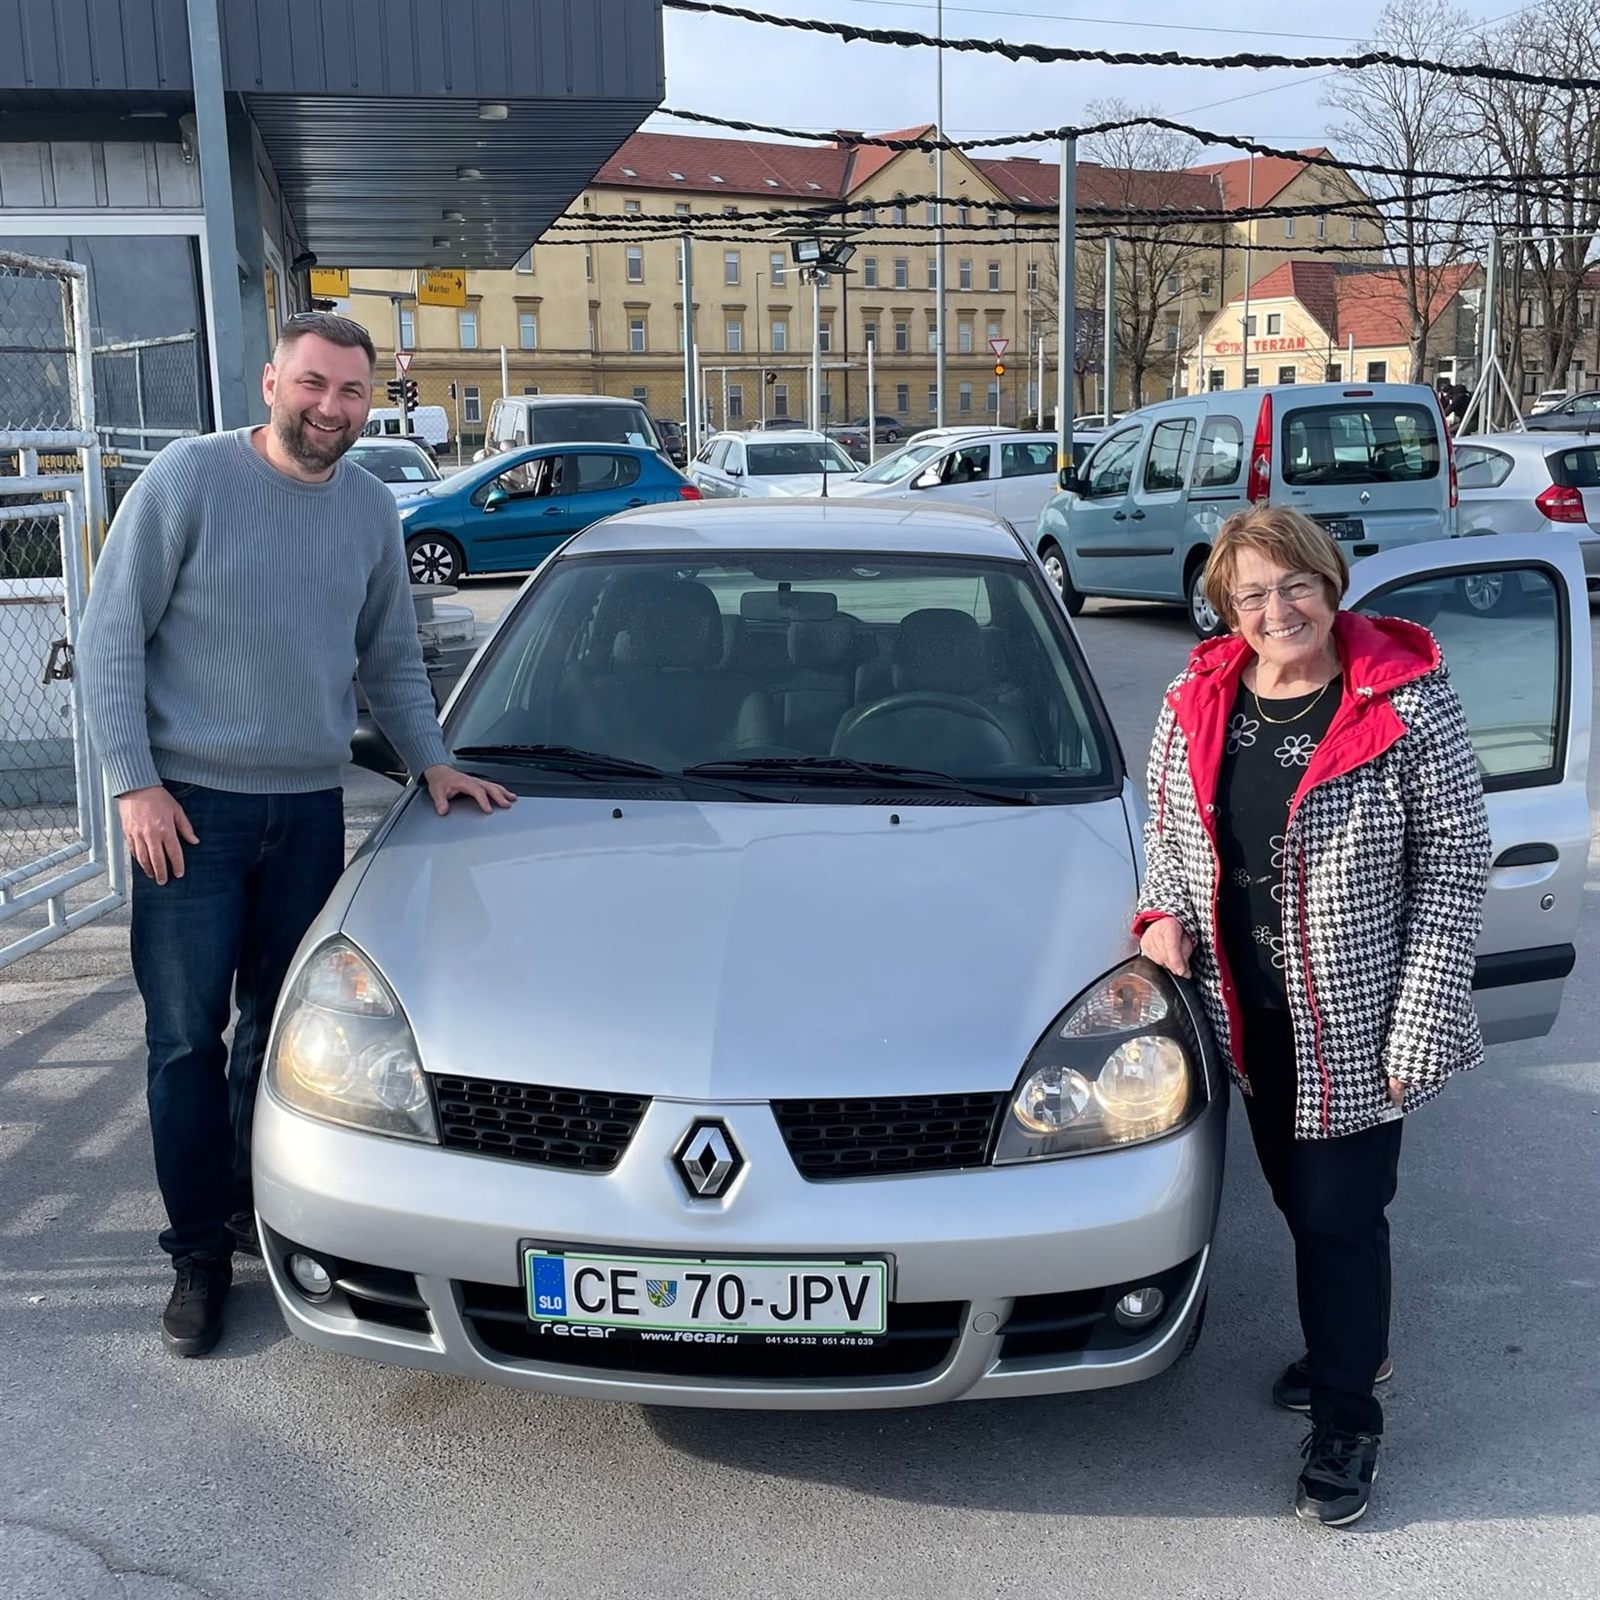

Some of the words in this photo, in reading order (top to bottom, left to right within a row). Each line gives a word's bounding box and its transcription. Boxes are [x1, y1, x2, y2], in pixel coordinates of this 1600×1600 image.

[573, 1267, 640, 1316] CE
[683, 1272, 871, 1321] 70-JPV
[538, 1295, 562, 1311] SLO
[540, 1323, 616, 1339] recar
[641, 1331, 738, 1344] www.recar.si
[765, 1336, 781, 1344] 041
[783, 1336, 799, 1345] 434
[801, 1337, 817, 1345] 232
[822, 1337, 837, 1345] 051
[839, 1337, 855, 1345] 478
[857, 1337, 874, 1346] 039
